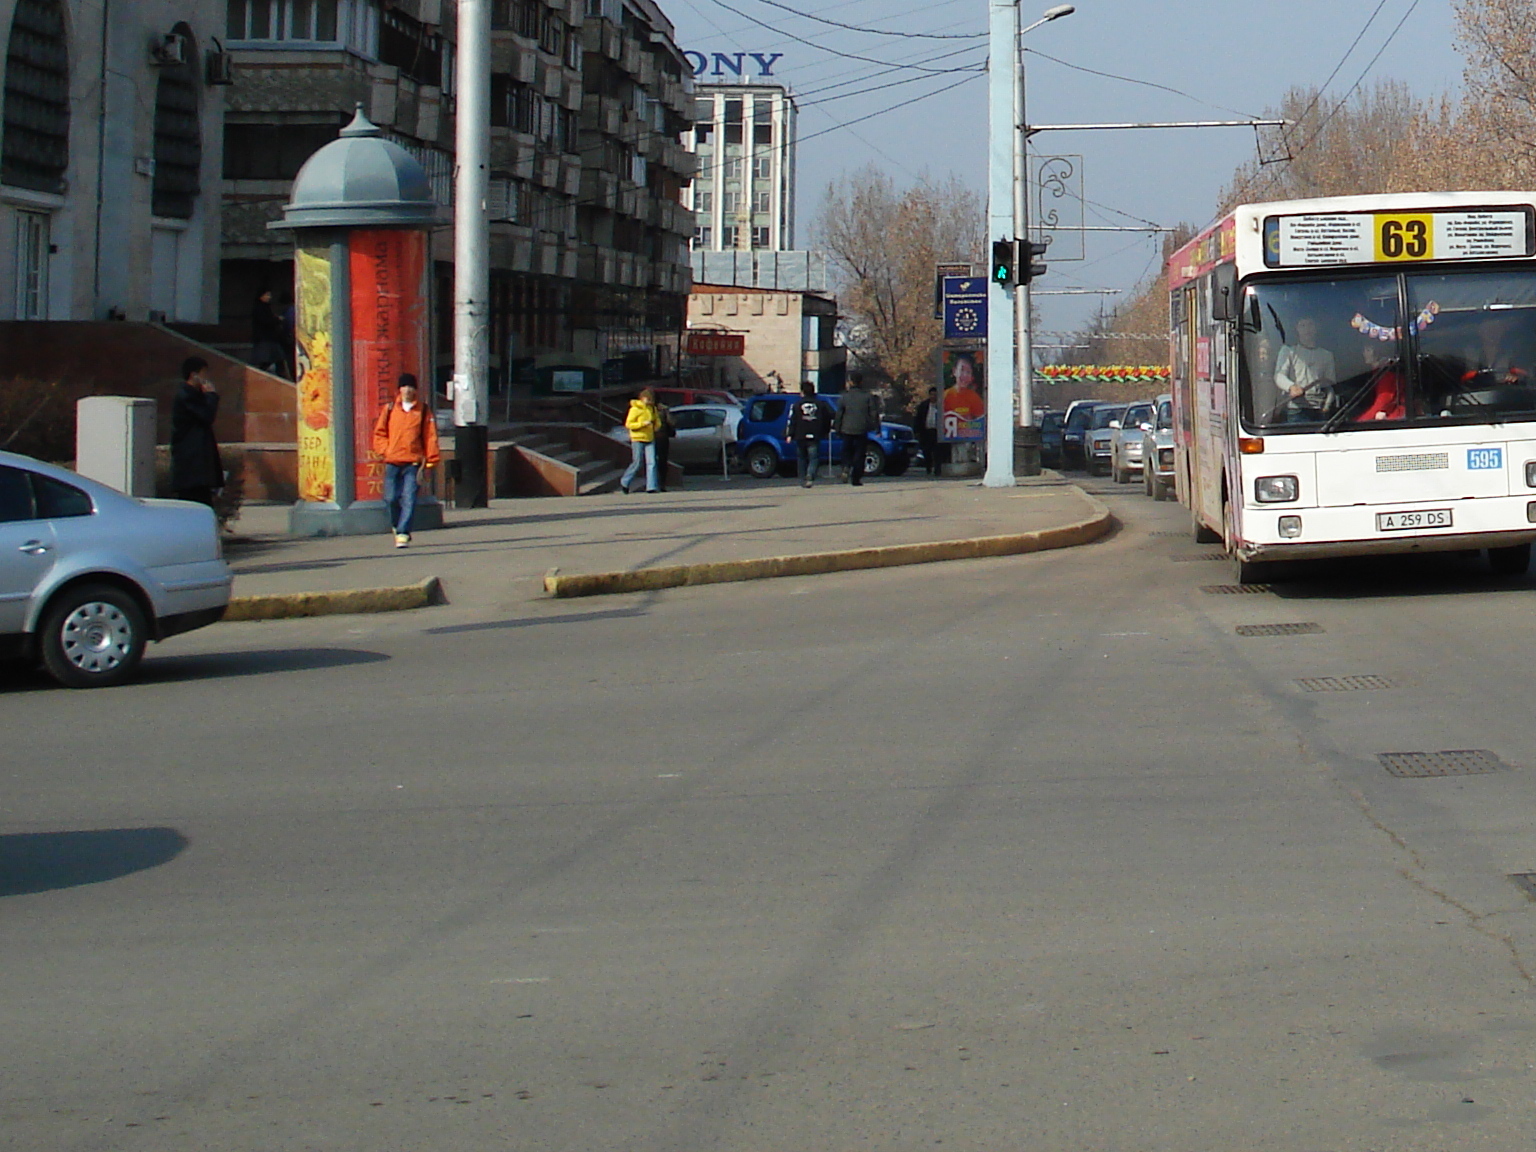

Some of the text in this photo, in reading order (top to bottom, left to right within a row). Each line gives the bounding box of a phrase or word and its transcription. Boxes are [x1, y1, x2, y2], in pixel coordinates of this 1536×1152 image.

[682, 50, 784, 76] ONY
[1381, 220, 1427, 257] 63
[1470, 450, 1499, 468] 595
[1386, 512, 1444, 526] A 259 DS
